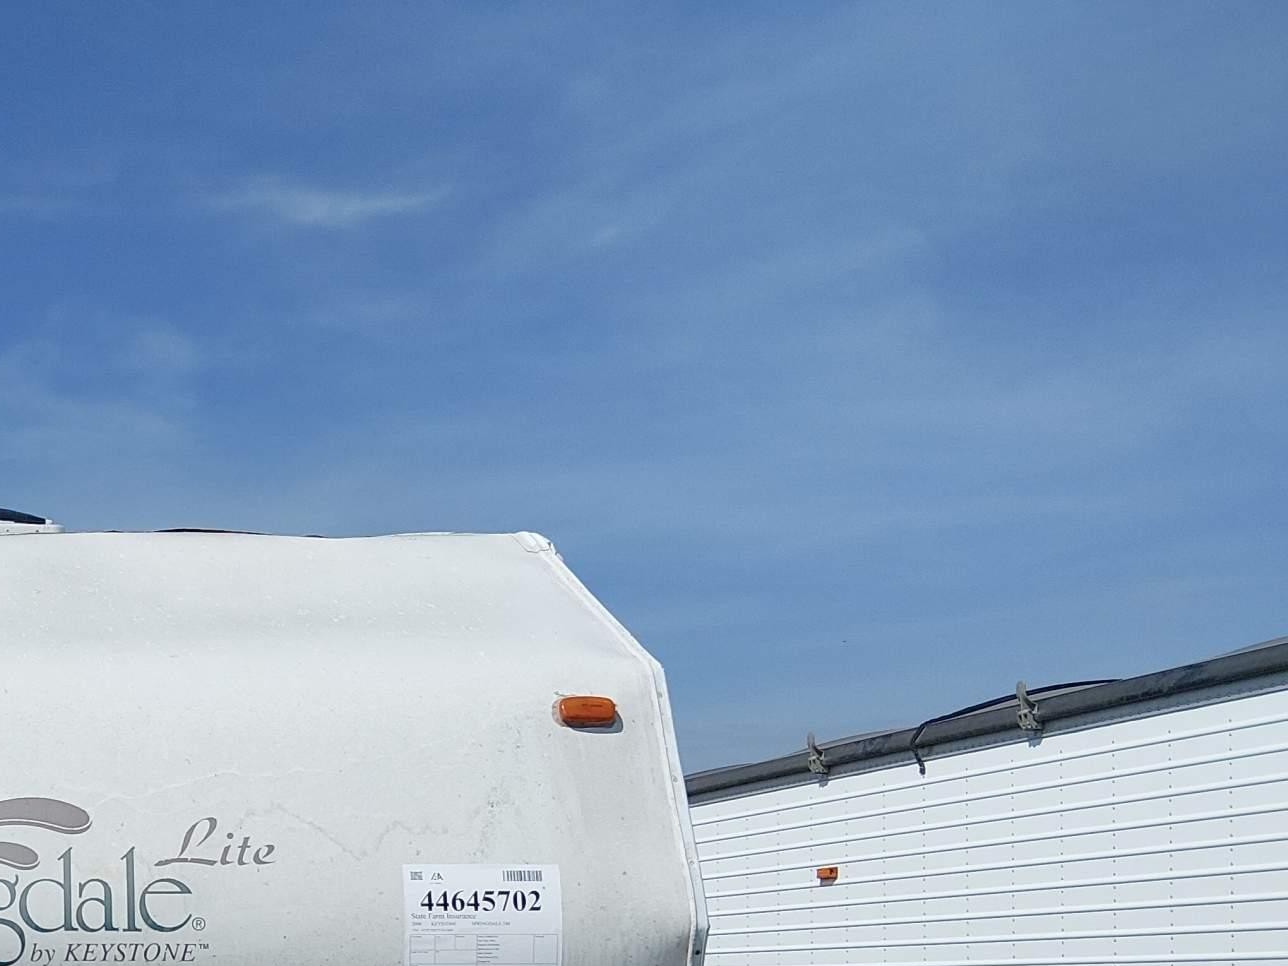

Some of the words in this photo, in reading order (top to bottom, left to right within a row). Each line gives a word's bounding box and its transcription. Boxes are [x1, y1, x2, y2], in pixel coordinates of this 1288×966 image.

[154, 816, 276, 867] Lite
[420, 890, 542, 912] 44645702
[30, 943, 56, 966] by
